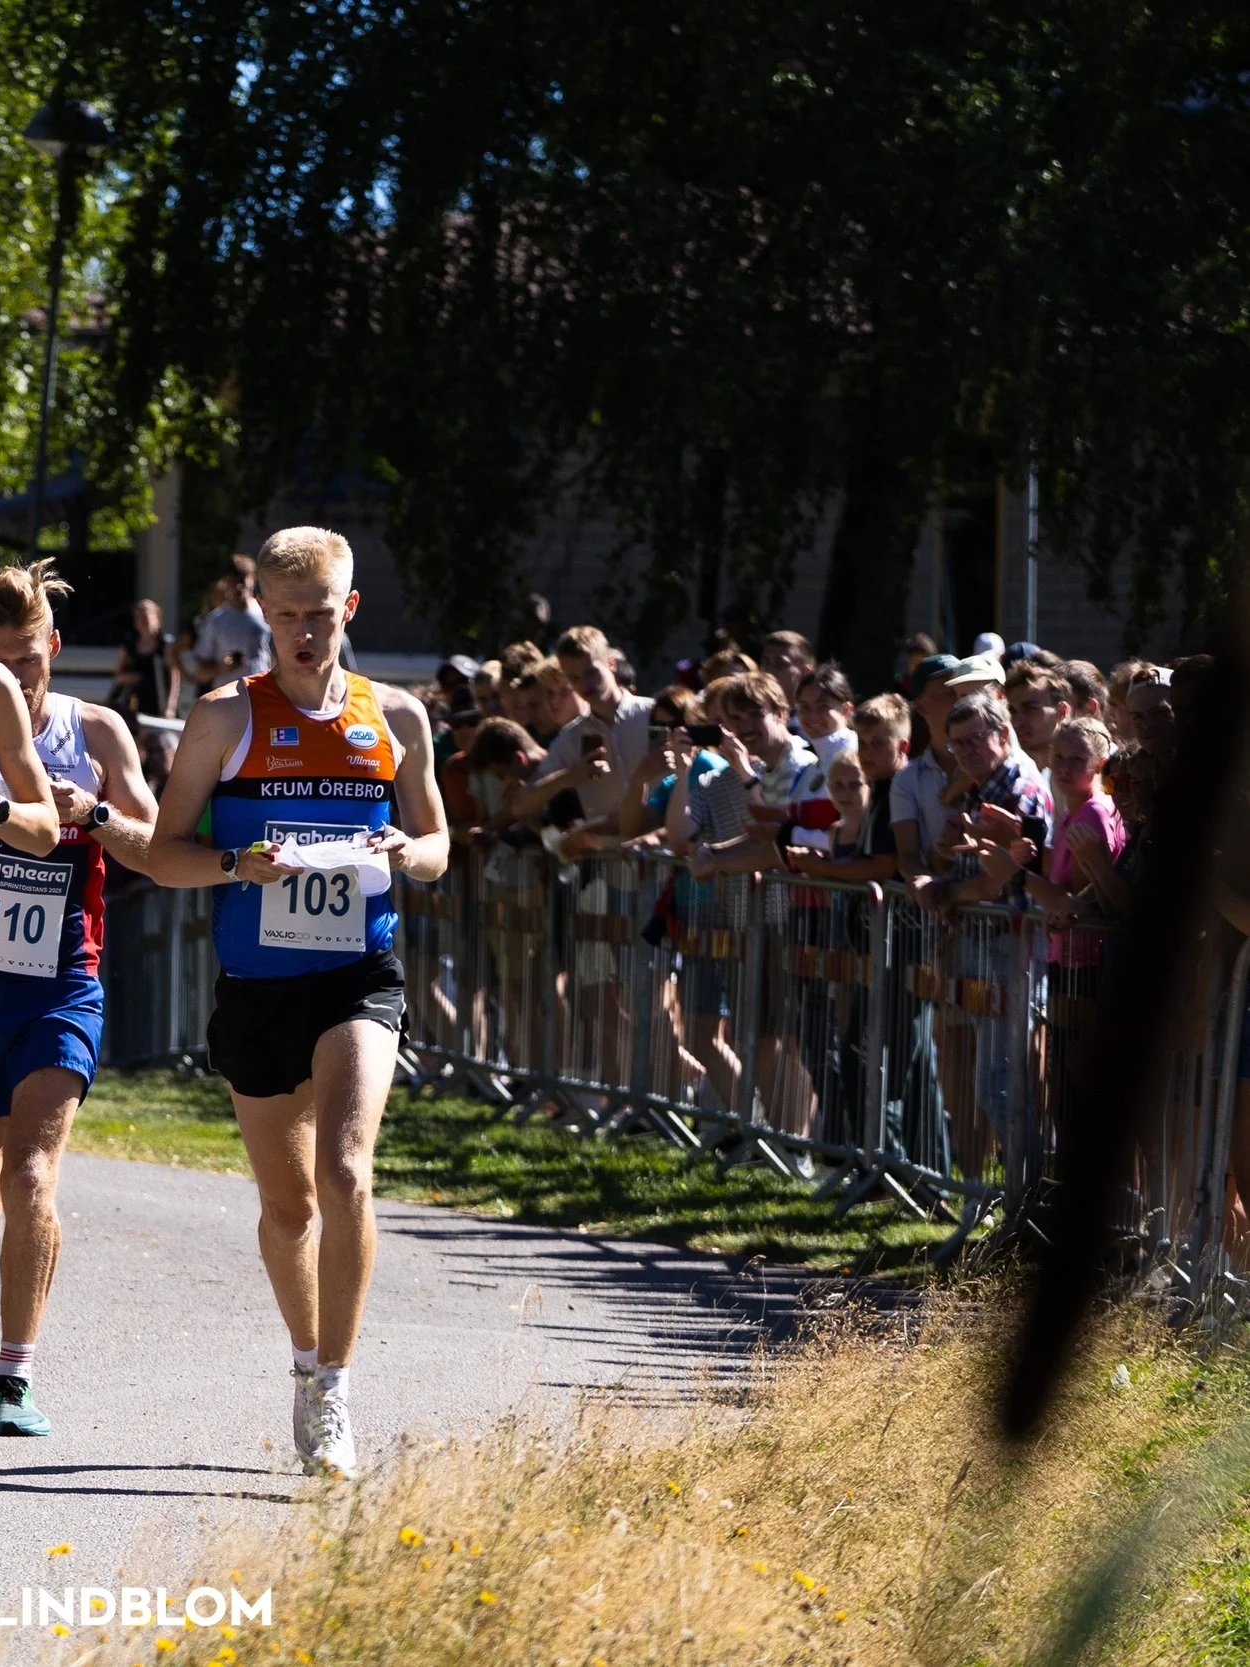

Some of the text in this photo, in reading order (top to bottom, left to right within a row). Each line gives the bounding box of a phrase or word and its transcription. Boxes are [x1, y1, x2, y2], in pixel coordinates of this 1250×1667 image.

[346, 755, 381, 767] Ullmax
[261, 778, 384, 799] KFUM ÖREBRO
[0, 881, 47, 893] SPRINTDISTANS
[281, 872, 350, 917] 103
[8, 960, 54, 970] VOLVO
